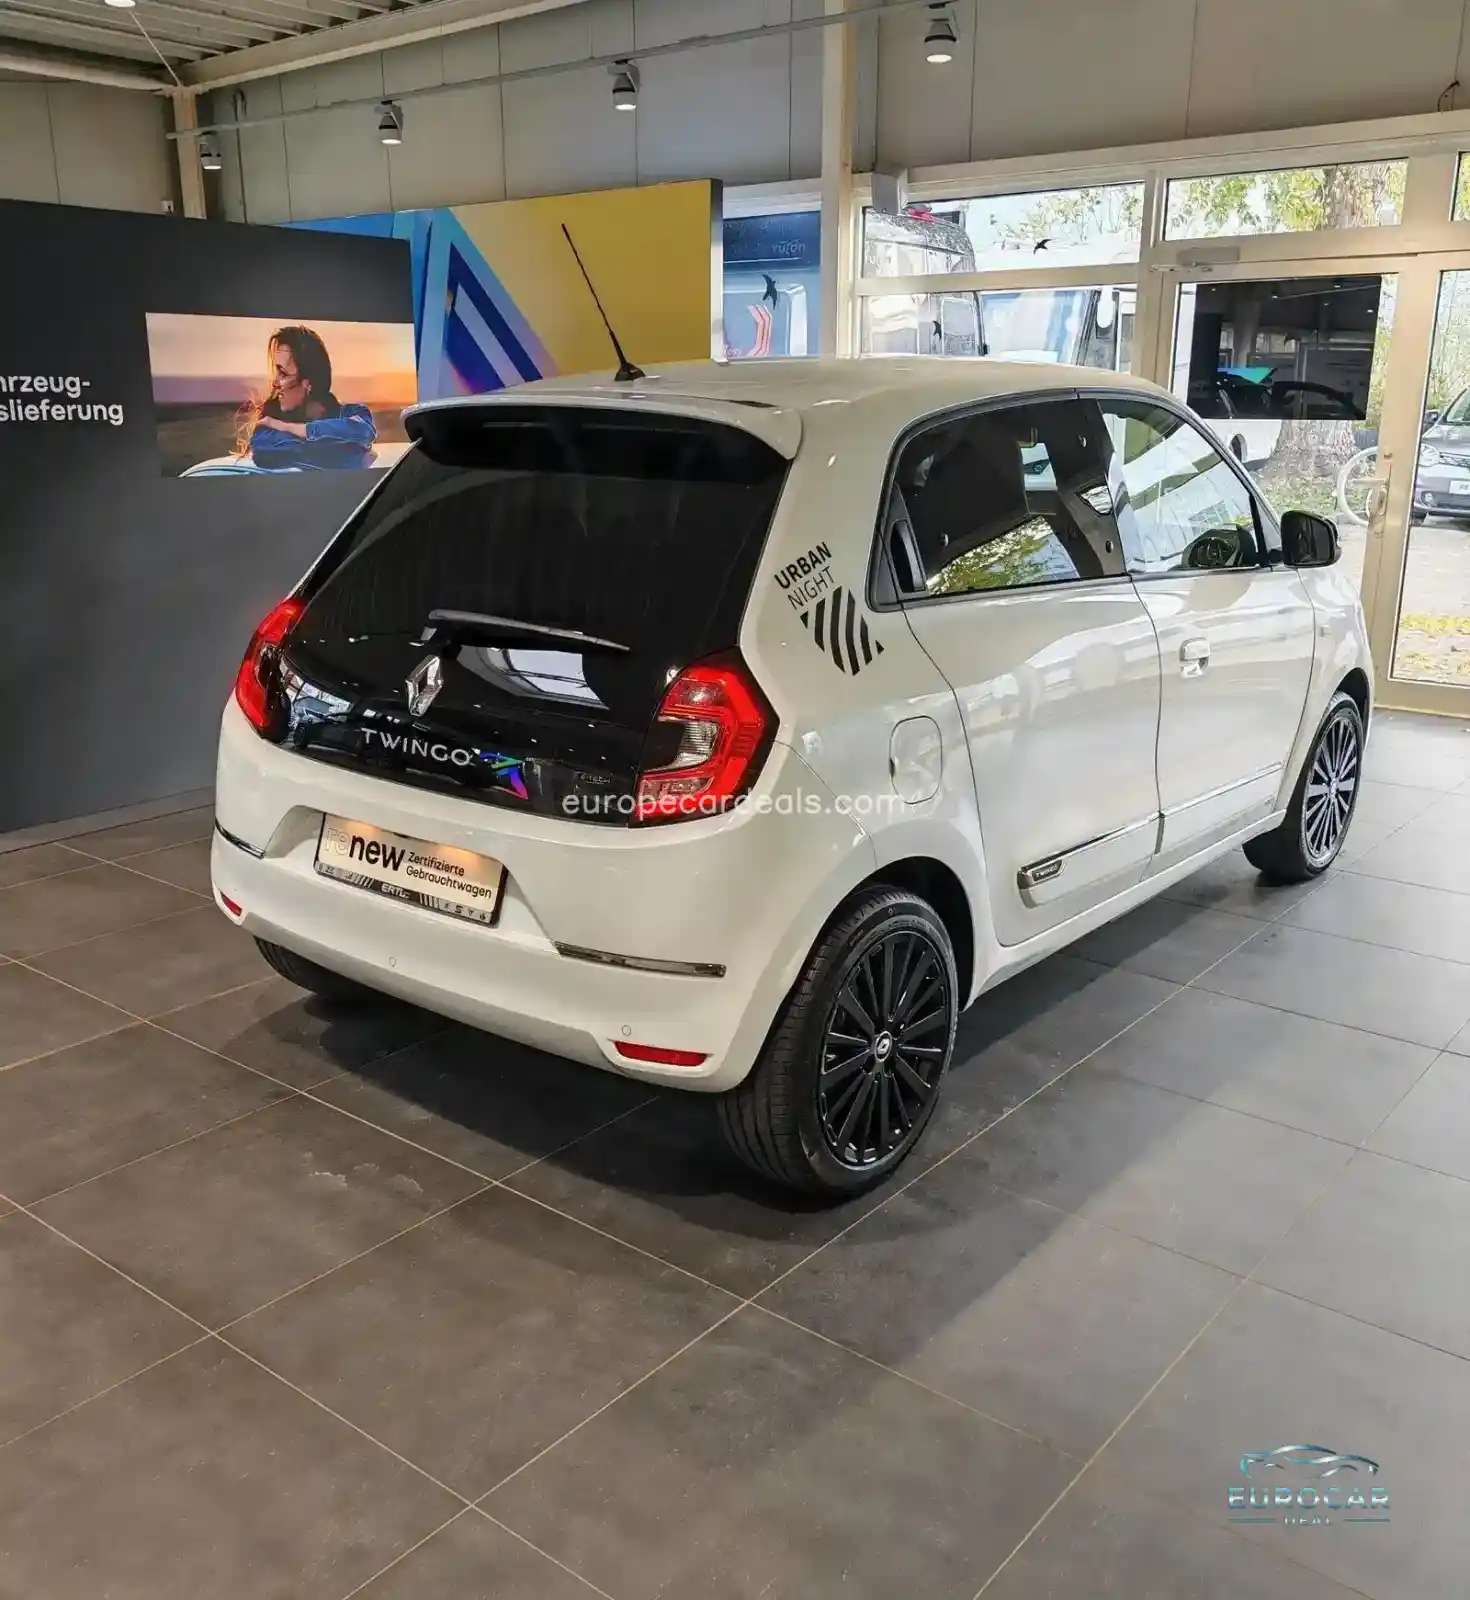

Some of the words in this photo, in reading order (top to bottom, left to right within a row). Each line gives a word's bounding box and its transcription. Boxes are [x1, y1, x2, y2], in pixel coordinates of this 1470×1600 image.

[774, 541, 832, 589] URBAN
[787, 565, 835, 610] NIGHT
[361, 727, 471, 766] TWINGO
[325, 827, 406, 871] renew
[408, 851, 465, 877] Zertifizierte
[406, 865, 492, 900] Gebrauchtwagen
